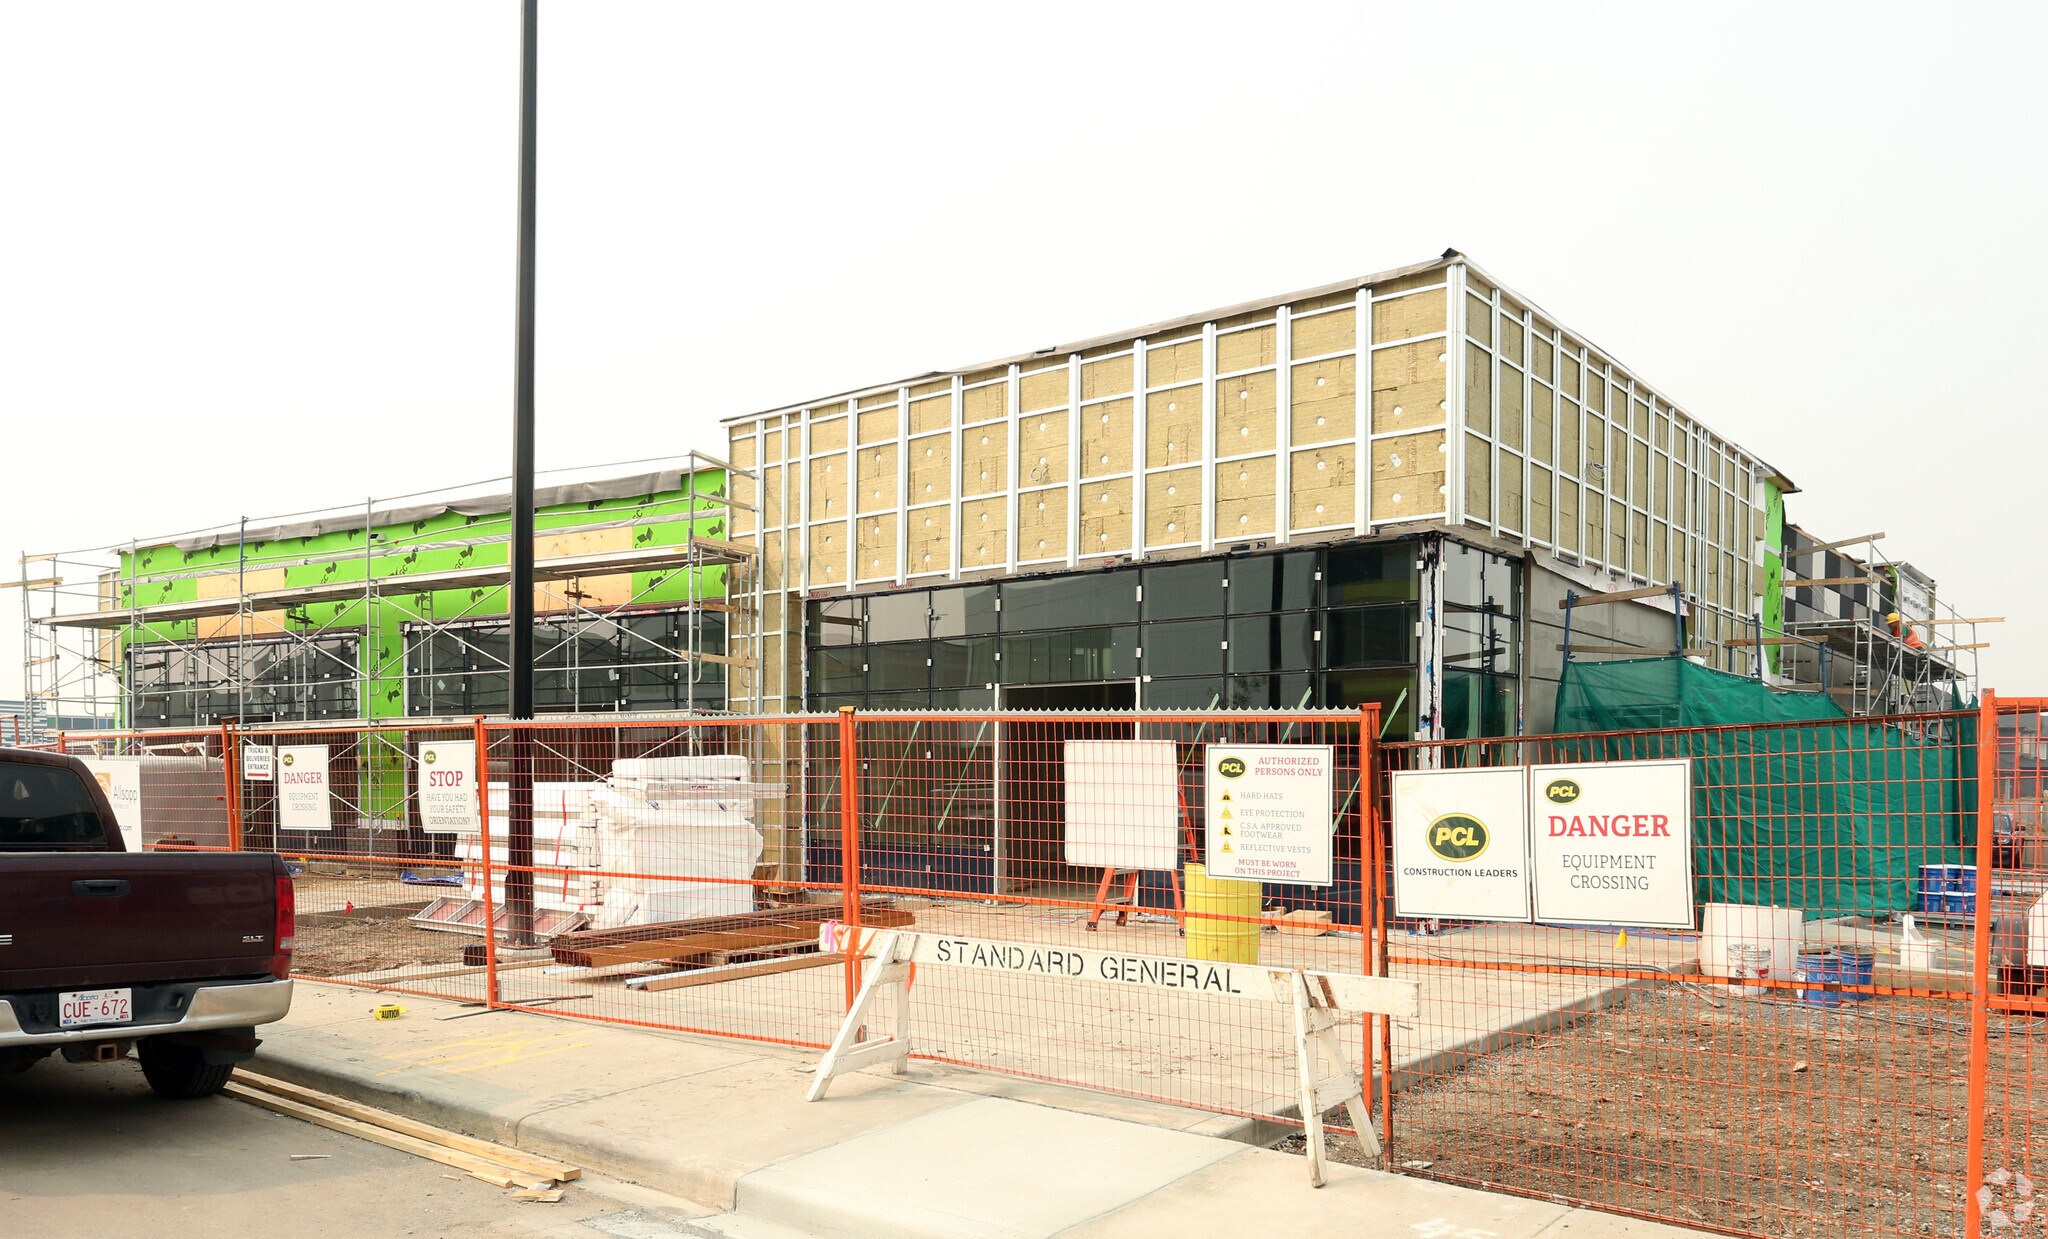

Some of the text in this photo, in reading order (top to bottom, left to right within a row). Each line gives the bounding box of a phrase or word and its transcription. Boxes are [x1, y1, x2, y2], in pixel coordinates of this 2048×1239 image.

[1258, 757, 1320, 766] AUTHORIZED
[1221, 763, 1243, 773] PCL
[1255, 768, 1323, 777] PERSONS ONLY
[284, 772, 322, 784] DANGER
[429, 771, 463, 787] STOP
[113, 785, 138, 804] Allsopp
[289, 792, 319, 801] EQUIPMENT
[427, 793, 467, 801] HAVE YOU HAD
[1240, 792, 1283, 800] HARD HATS
[1550, 786, 1576, 798] PCL
[291, 803, 317, 811] CROSSING
[429, 805, 466, 813] YOUR SAFETY
[1240, 809, 1305, 818] EYE PROTECTION
[429, 816, 470, 825] ORIENTATION?
[1548, 814, 1670, 837] DANGER
[1240, 822, 1302, 832] C.S.A. APPROVED
[1240, 831, 1282, 839] FOOTWEAR
[1435, 827, 1479, 846] PCL
[1240, 843, 1311, 854] REFLECTIVE VESTS
[1238, 859, 1260, 867] MUST
[1272, 860, 1296, 868] WORN
[1562, 854, 1656, 871] EQUIPMENT
[1247, 868, 1265, 876] THIS
[1267, 869, 1301, 878] PROJECT
[1403, 868, 1518, 878] CONSTRUCTION LEADERS
[1570, 875, 1650, 890] CROSSING
[937, 939, 1241, 994] STANDARD GENERAL
